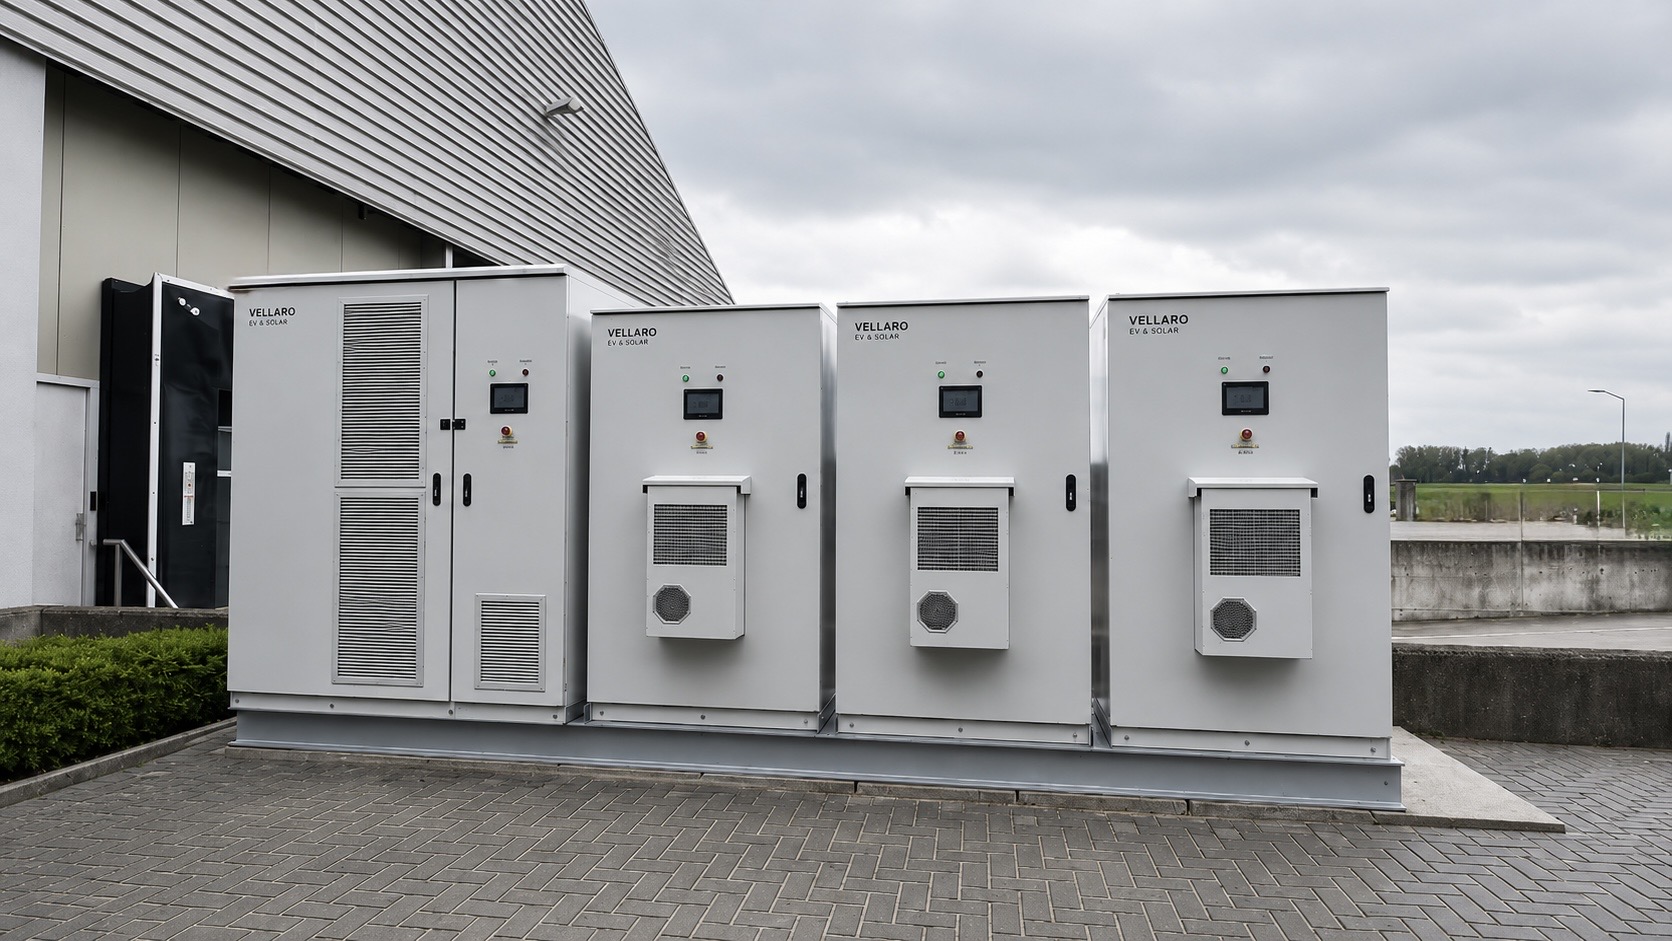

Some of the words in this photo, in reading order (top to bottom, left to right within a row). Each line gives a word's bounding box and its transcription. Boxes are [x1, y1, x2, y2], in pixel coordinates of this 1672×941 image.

[249, 307, 296, 317] VELLARO
[1129, 314, 1189, 325] VELLARO
[855, 321, 909, 331] VELLARO
[1151, 327, 1179, 335] SOLAR
[607, 327, 657, 337] VELLARO
